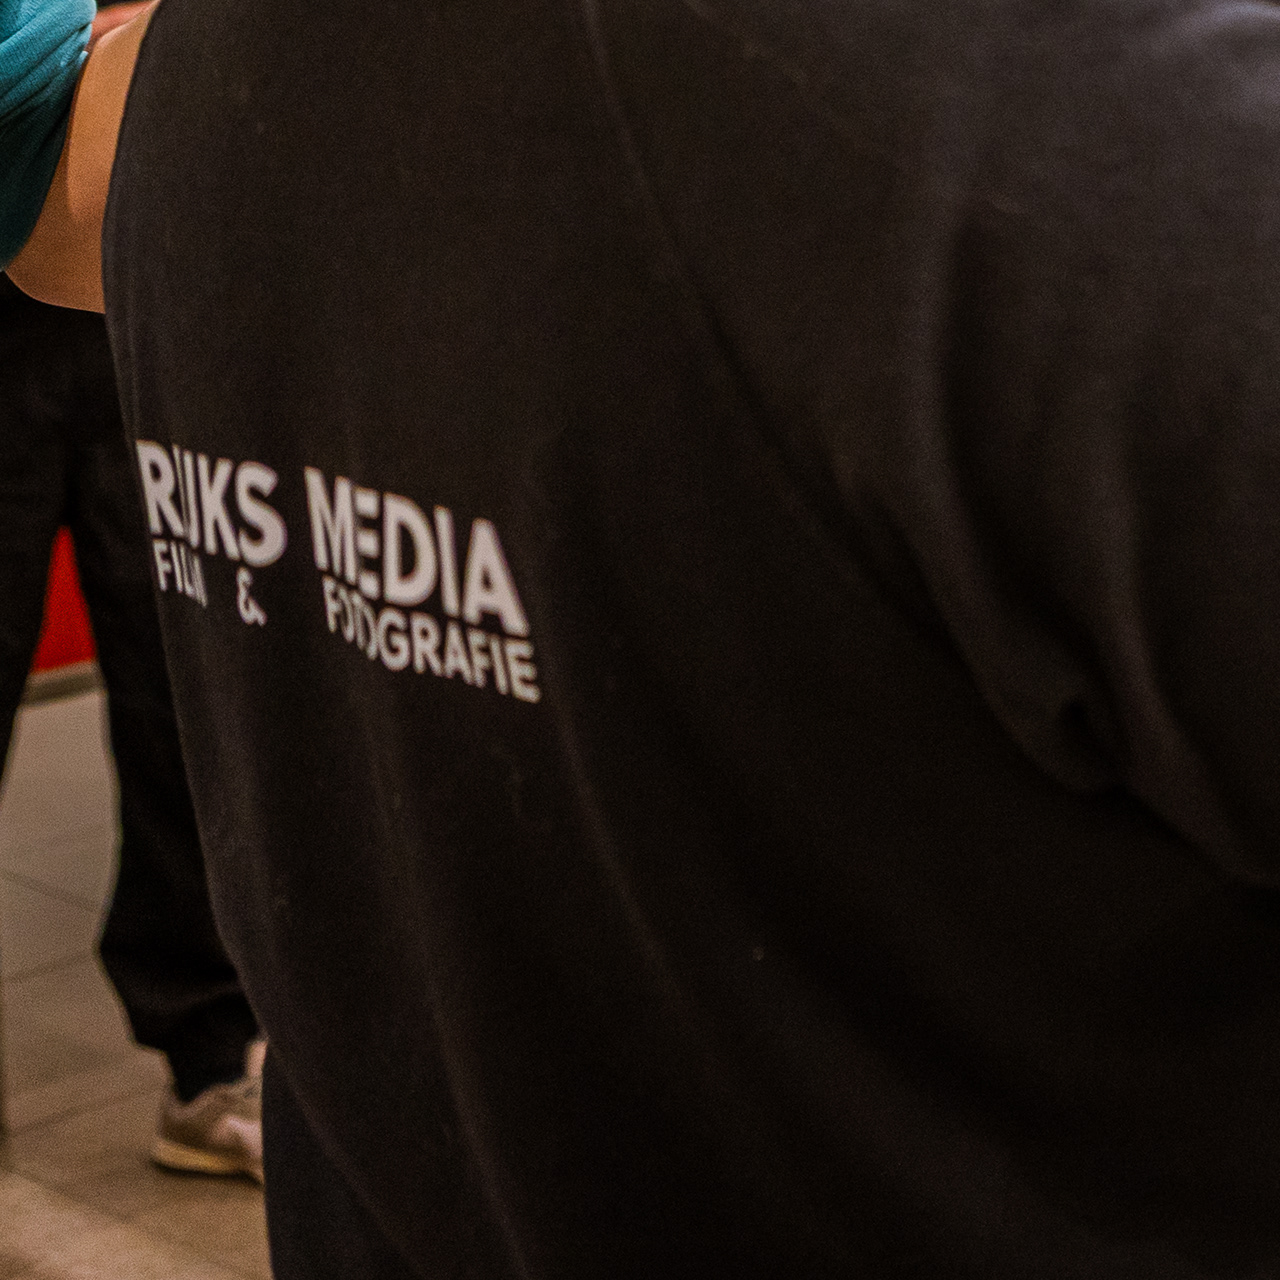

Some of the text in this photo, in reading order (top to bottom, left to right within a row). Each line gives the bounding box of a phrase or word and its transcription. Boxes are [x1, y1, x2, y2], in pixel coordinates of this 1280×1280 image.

[135, 439, 530, 638] RIJKS MEDIA
[235, 566, 268, 628] &
[322, 574, 542, 705] FOTOGRAFIE
